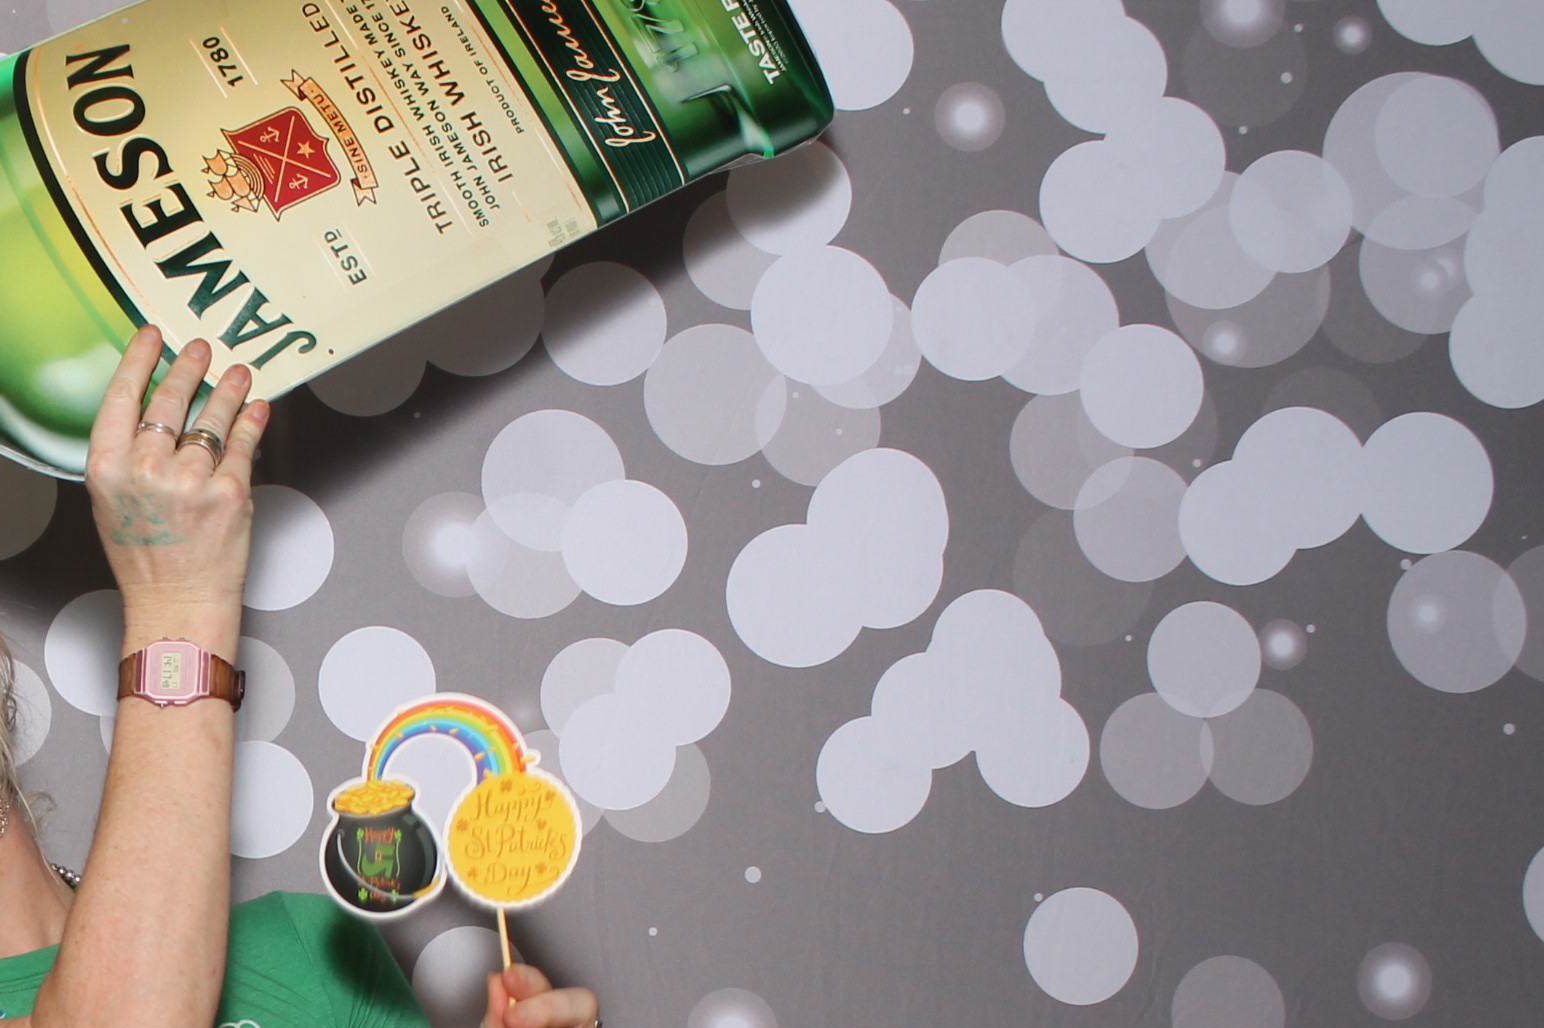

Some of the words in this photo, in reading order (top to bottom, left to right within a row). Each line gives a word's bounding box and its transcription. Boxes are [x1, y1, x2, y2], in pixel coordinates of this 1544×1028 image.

[346, 4, 378, 45] MADE
[371, 12, 406, 58] SINCE
[441, 6, 477, 57] IRELAND
[541, 0, 621, 83] Jame
[731, 12, 780, 85] TASTE
[203, 36, 244, 88] 1780
[302, 3, 395, 134] DISTILLED
[385, 0, 466, 106] WHISKE
[402, 62, 429, 96] WAY
[474, 60, 488, 75] OF
[312, 92, 347, 133] METU
[374, 50, 425, 121] WHISKEY
[486, 79, 525, 134] PRODUCT
[427, 99, 478, 171] JAMESON
[594, 86, 656, 148] John
[343, 135, 369, 175] SINE
[422, 124, 454, 167] IRISH
[460, 111, 513, 183] IRISH
[65, 44, 317, 370] JAMESON
[388, 140, 453, 235] TRIPLE
[450, 170, 489, 228] SMOOTH
[473, 175, 500, 209] JOHN
[323, 228, 367, 286] ESTD
[470, 787, 543, 822] Happy
[484, 862, 532, 896] Day
